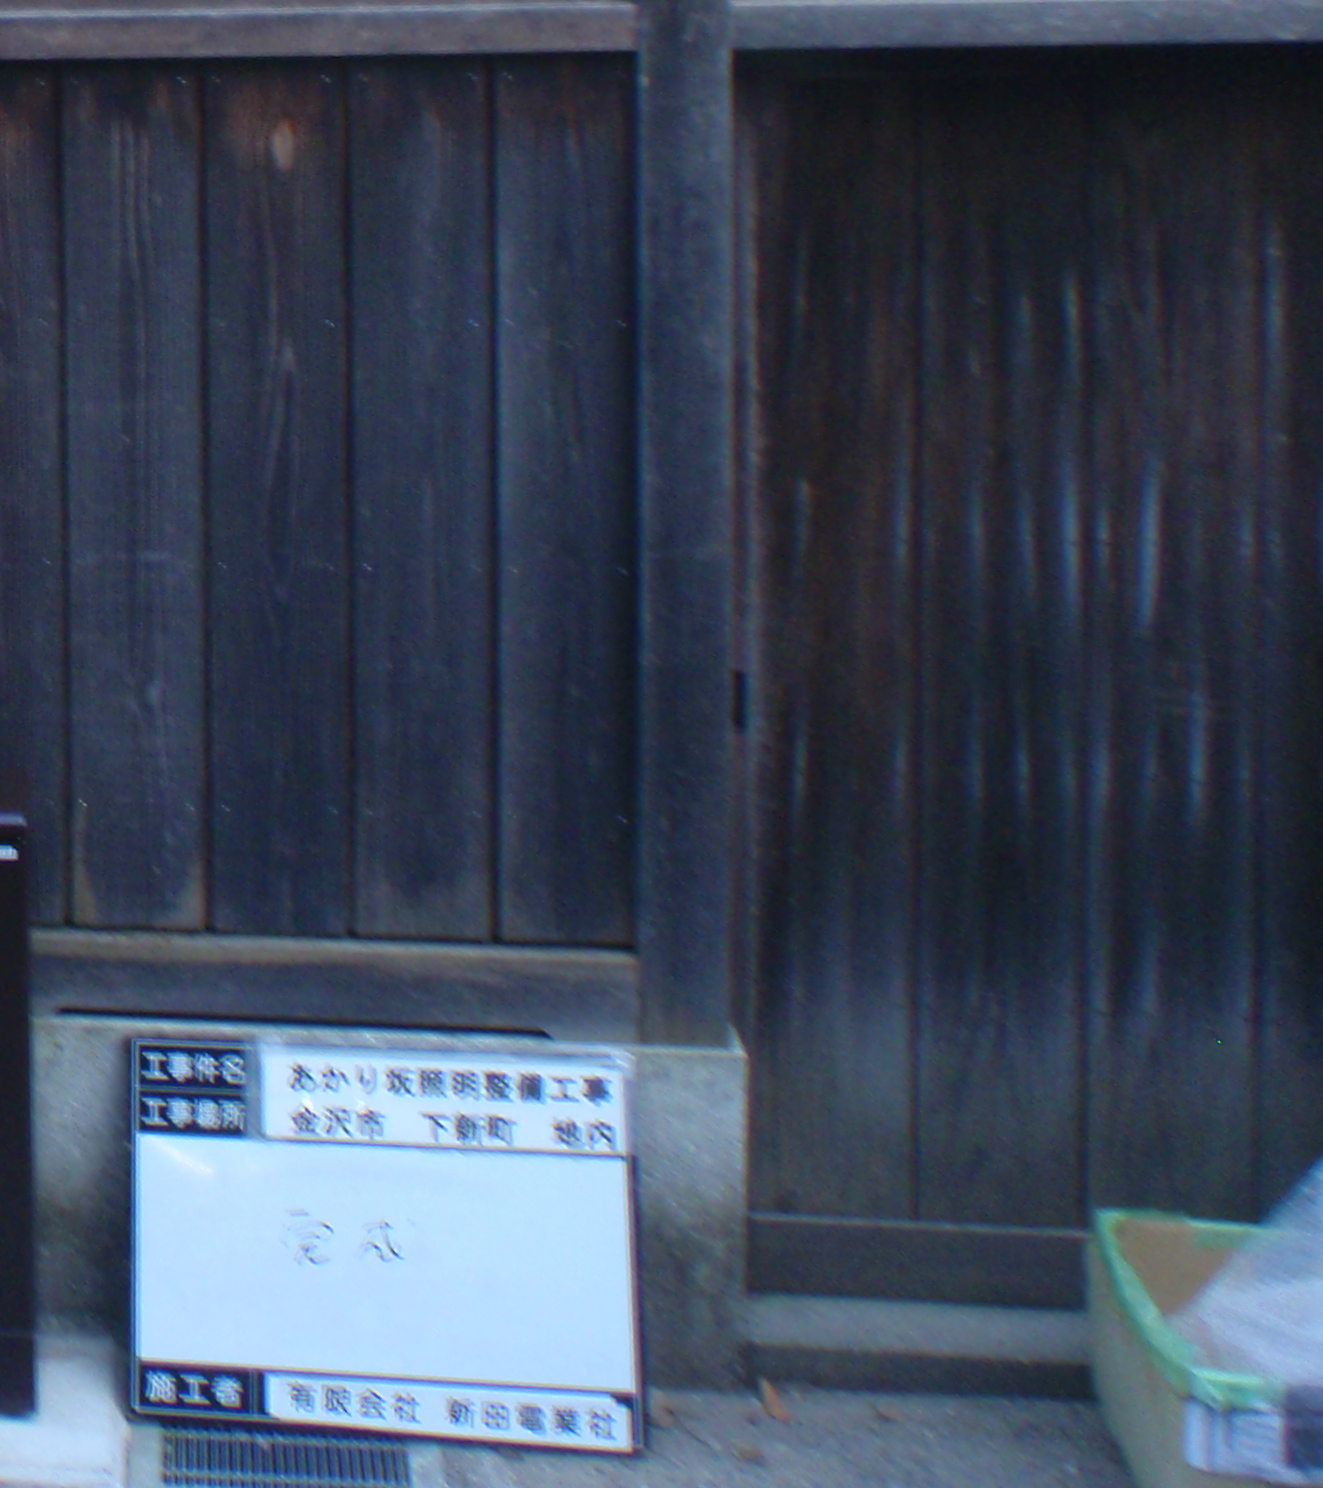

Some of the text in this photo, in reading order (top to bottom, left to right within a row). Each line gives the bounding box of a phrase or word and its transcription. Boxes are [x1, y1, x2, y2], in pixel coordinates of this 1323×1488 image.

[289, 1105, 385, 1140] 金沢市
[419, 1111, 517, 1147] 下新町
[145, 1368, 244, 1409] 施工者
[286, 1379, 617, 1441] 有限会社 新田電業社
